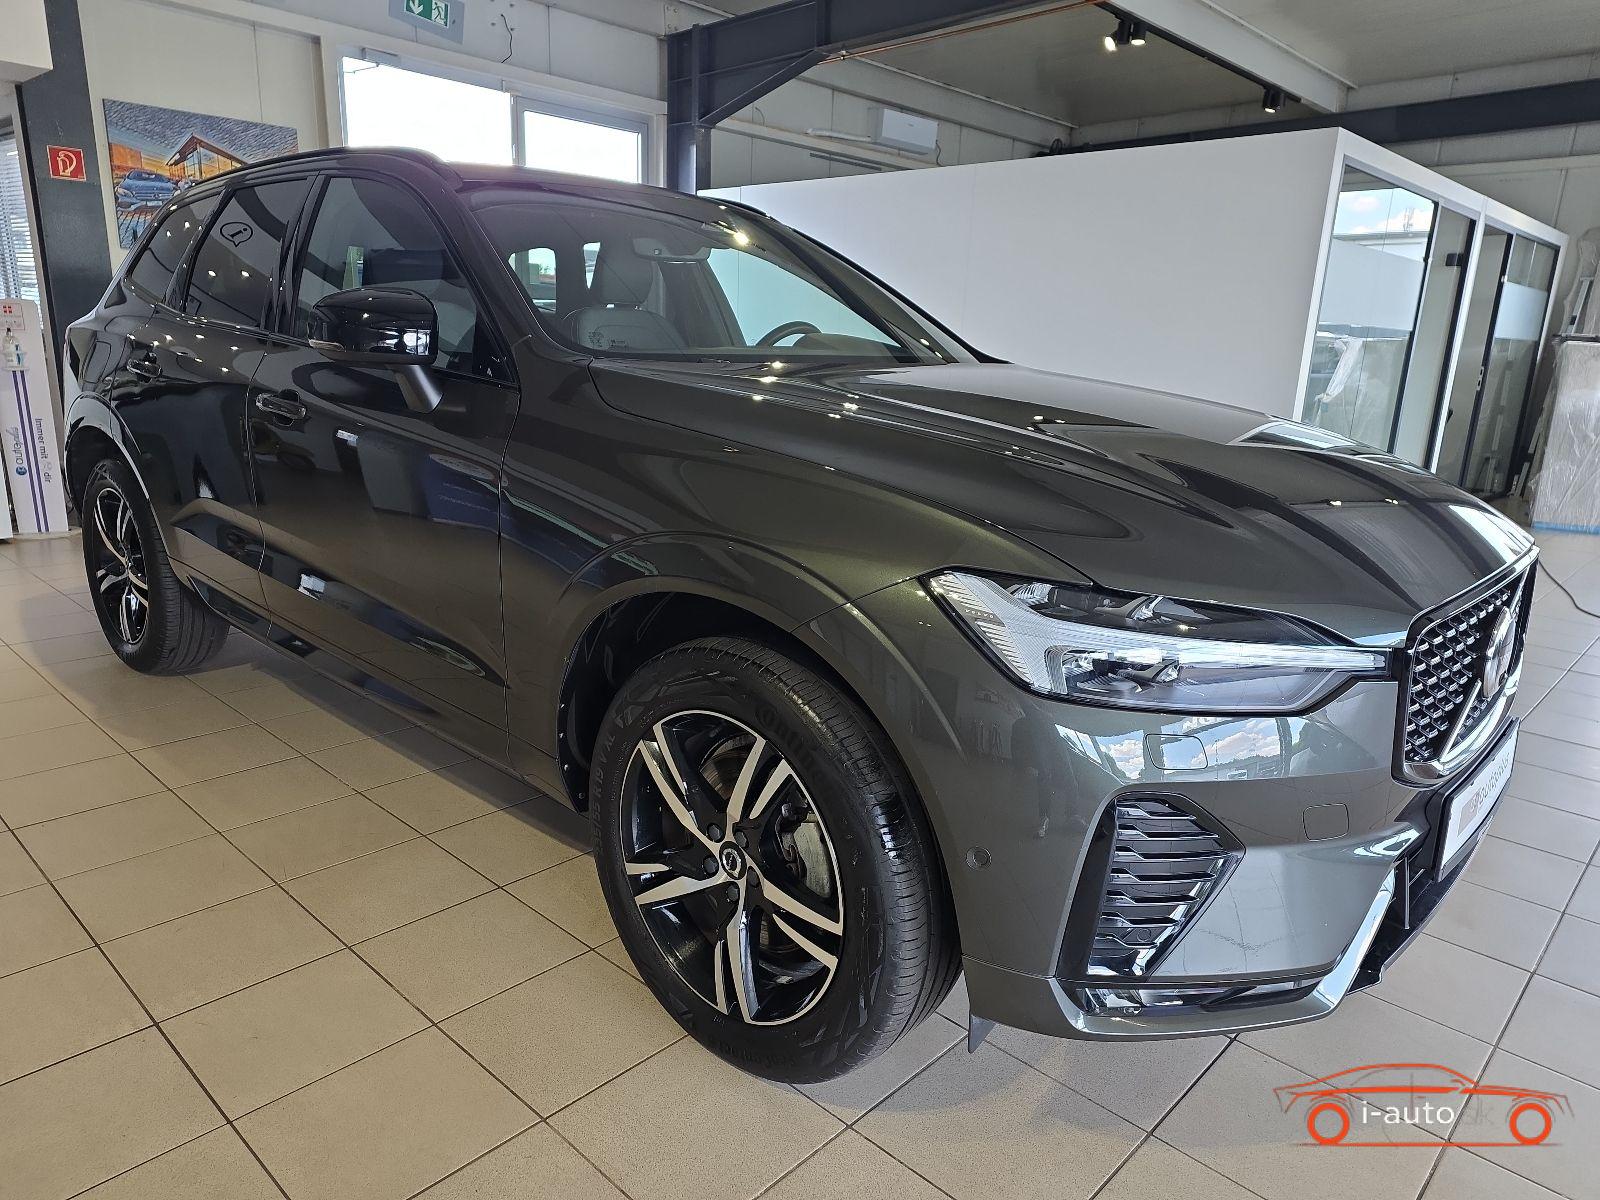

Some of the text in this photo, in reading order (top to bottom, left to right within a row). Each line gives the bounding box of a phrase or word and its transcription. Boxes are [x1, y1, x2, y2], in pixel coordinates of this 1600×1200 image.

[35, 418, 52, 483] Immer mit dir
[965, 609, 994, 618] VOLVO
